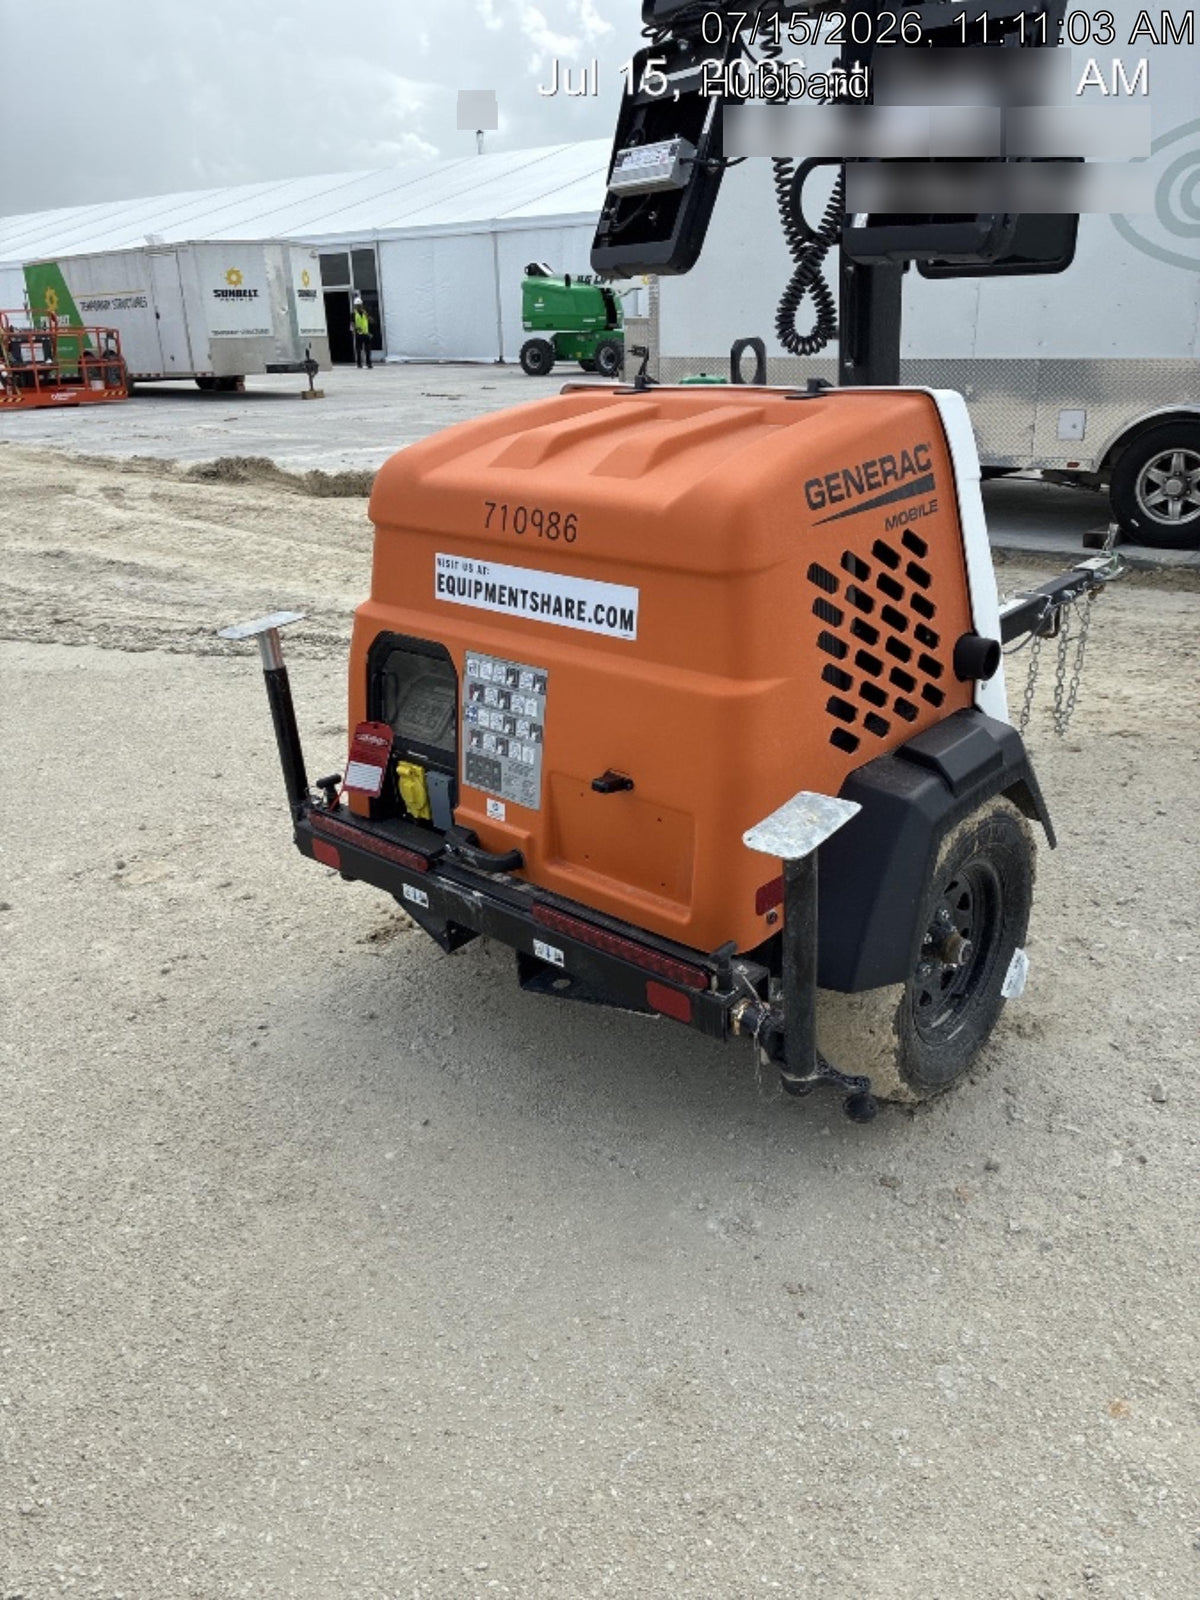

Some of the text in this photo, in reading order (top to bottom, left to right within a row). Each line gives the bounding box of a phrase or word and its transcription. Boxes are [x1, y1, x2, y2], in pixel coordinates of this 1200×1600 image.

[804, 443, 933, 511] GENERAC
[484, 501, 578, 543] 710986
[884, 499, 939, 532] MOBILE
[437, 557, 490, 576] VISIT US AT:
[437, 572, 635, 632] EQUIPMENTSHARE.COM
